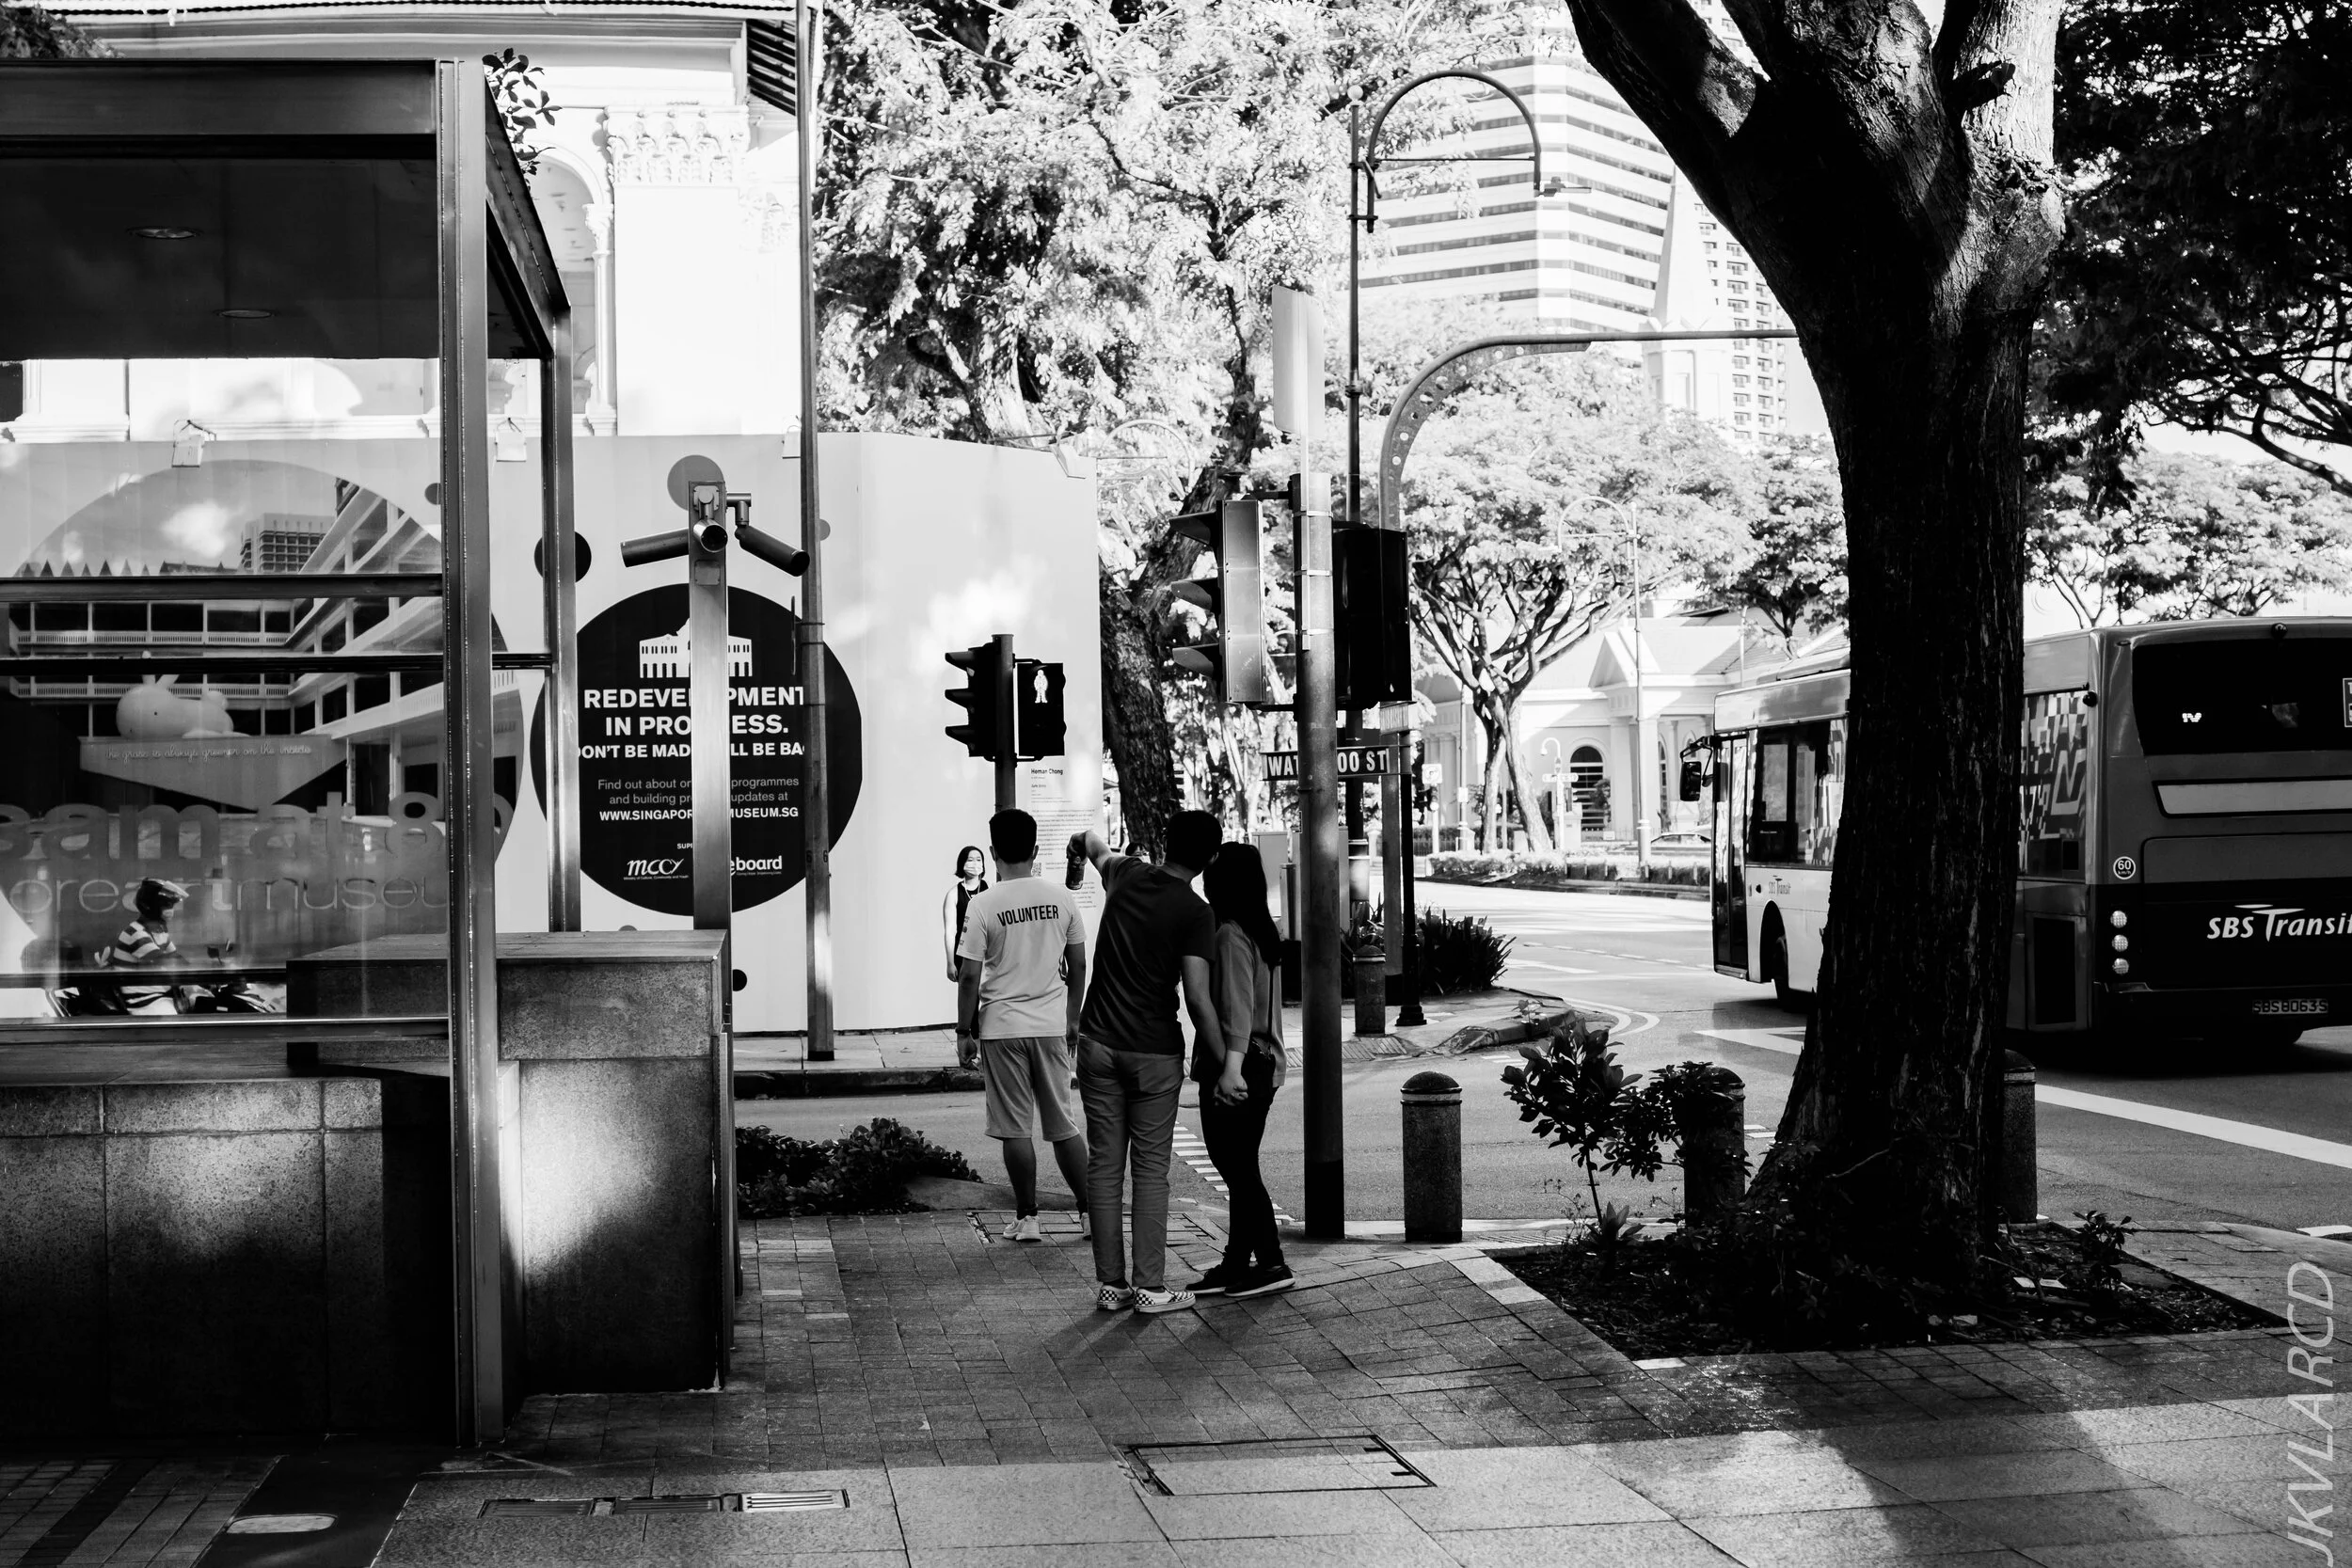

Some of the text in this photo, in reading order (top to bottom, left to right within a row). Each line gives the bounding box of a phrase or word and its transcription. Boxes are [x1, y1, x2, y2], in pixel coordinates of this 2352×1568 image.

[584, 687, 803, 708] REDEVEPMENT
[606, 715, 788, 736] IN PROESS.
[579, 745, 620, 758] ON'T
[625, 745, 647, 758] BE
[753, 743, 775, 755] BE
[1268, 751, 1386, 776] WATOO ST
[597, 779, 621, 790] Find
[625, 779, 642, 789] out
[645, 778, 676, 788] about
[731, 778, 800, 789] programmes
[610, 793, 629, 804] and
[633, 793, 675, 806] building
[731, 791, 774, 804] updates
[778, 792, 788, 800] at
[599, 807, 799, 820] WWW.SINGAPORUSEUM.SG
[2118, 861, 2131, 870] 60
[237, 878, 447, 911] museu
[997, 905, 1059, 927] VOLUNTEER
[2207, 916, 2254, 939] SBS
[2252, 1000, 2328, 1013] SBS8063S
